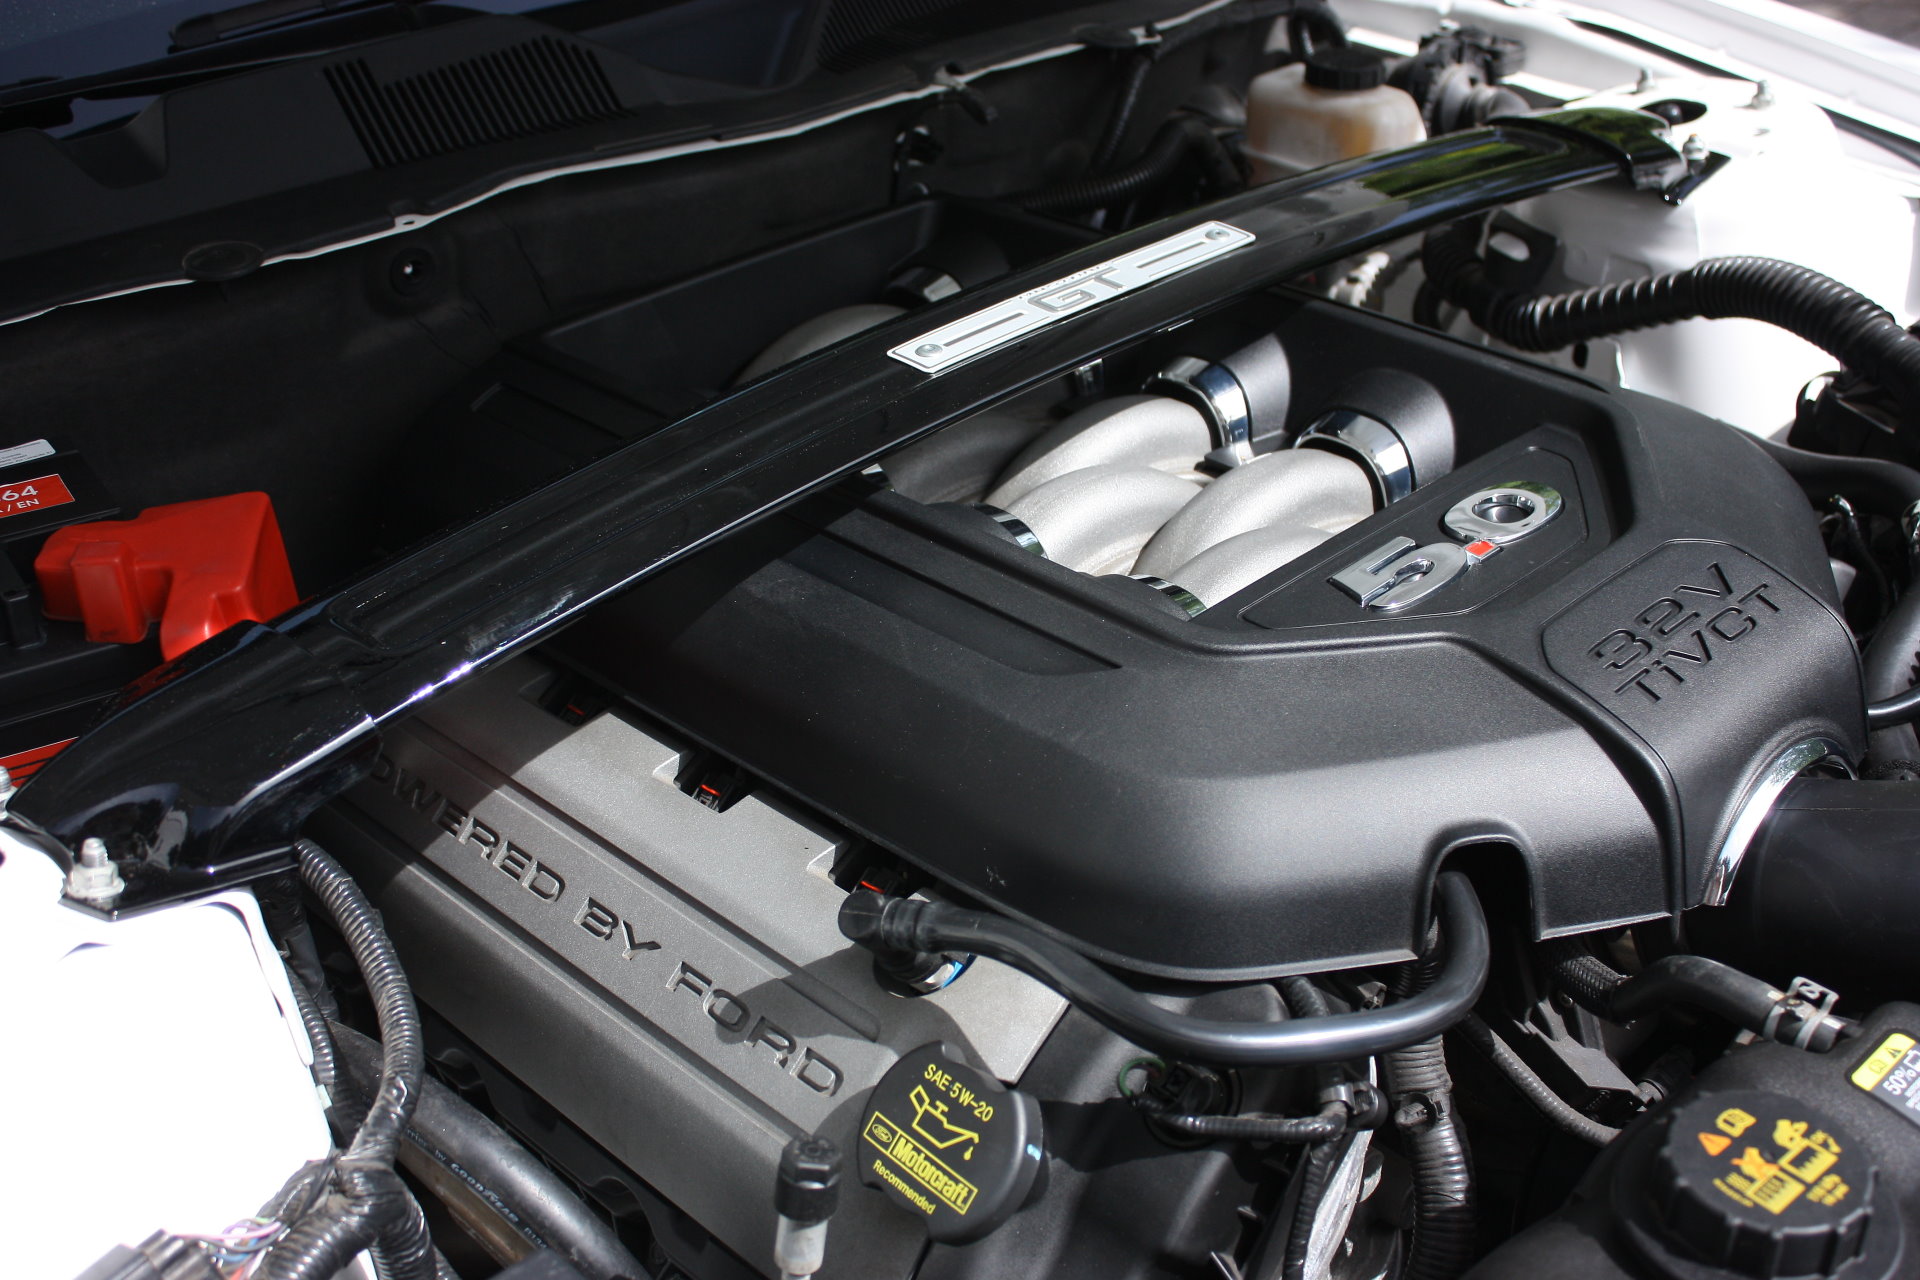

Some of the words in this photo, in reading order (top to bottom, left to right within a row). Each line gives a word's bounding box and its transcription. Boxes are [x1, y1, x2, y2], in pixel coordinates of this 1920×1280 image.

[1027, 266, 1127, 313] GT
[1587, 562, 1738, 672] 32V
[370, 748, 566, 902] OWERED
[573, 896, 662, 961] BY
[666, 961, 845, 1098] FORD
[924, 1064, 952, 1092] SAE
[949, 1082, 994, 1123] 5W-20
[872, 1159, 936, 1215] Recommended
[892, 1136, 970, 1208] Motorcraft
